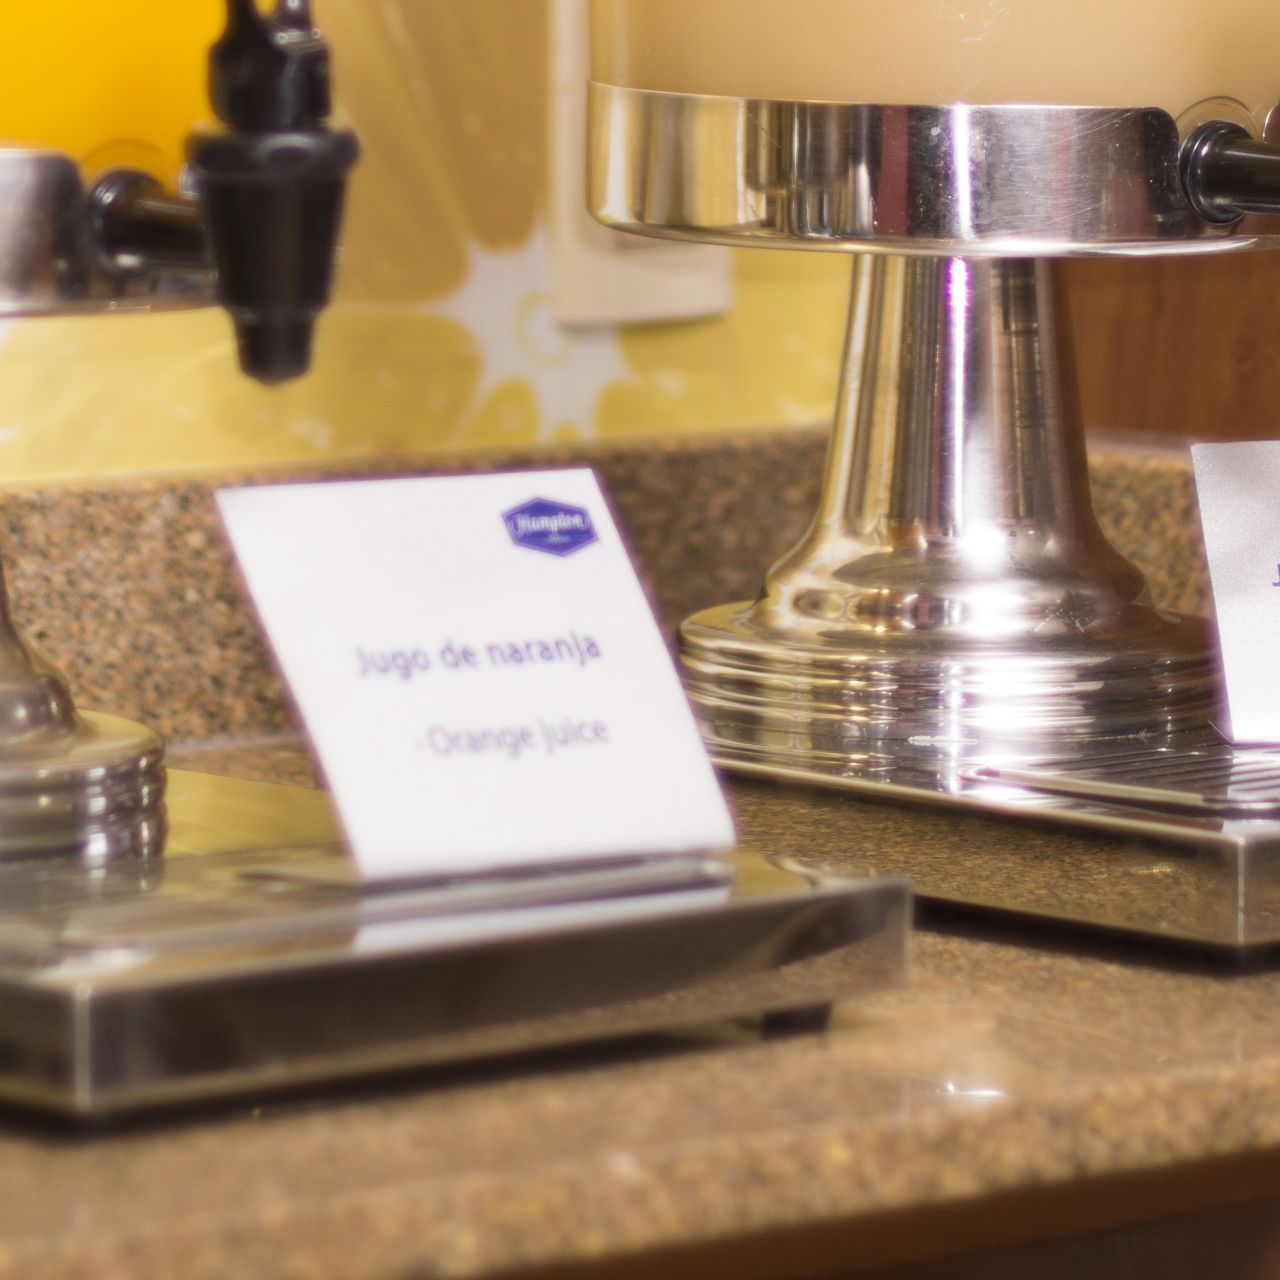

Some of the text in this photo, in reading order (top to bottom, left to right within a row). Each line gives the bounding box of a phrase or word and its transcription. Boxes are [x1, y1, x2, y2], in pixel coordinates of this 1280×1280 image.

[357, 631, 602, 681] Jugo de naranja
[426, 716, 609, 759] Orange juice
